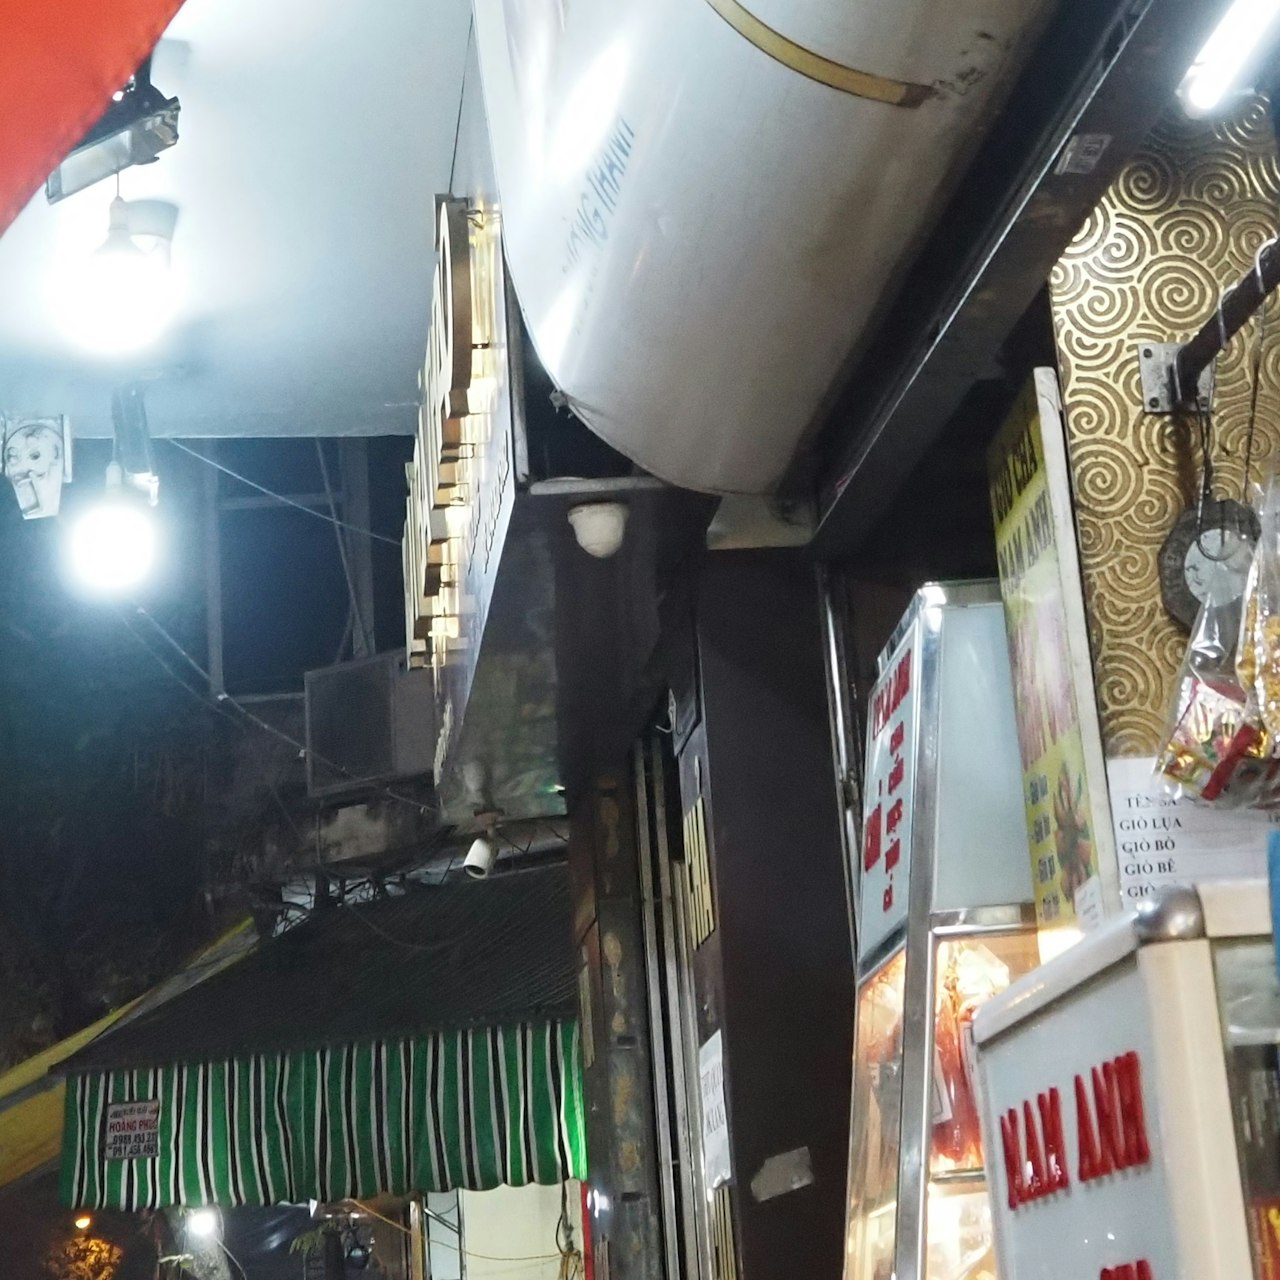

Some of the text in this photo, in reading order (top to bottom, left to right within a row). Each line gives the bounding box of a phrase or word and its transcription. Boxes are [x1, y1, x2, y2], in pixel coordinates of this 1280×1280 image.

[1119, 816, 1149, 832] GIÒ
[1122, 835, 1176, 854] GIÒ BÒ
[1124, 860, 1154, 876] GIÒ
